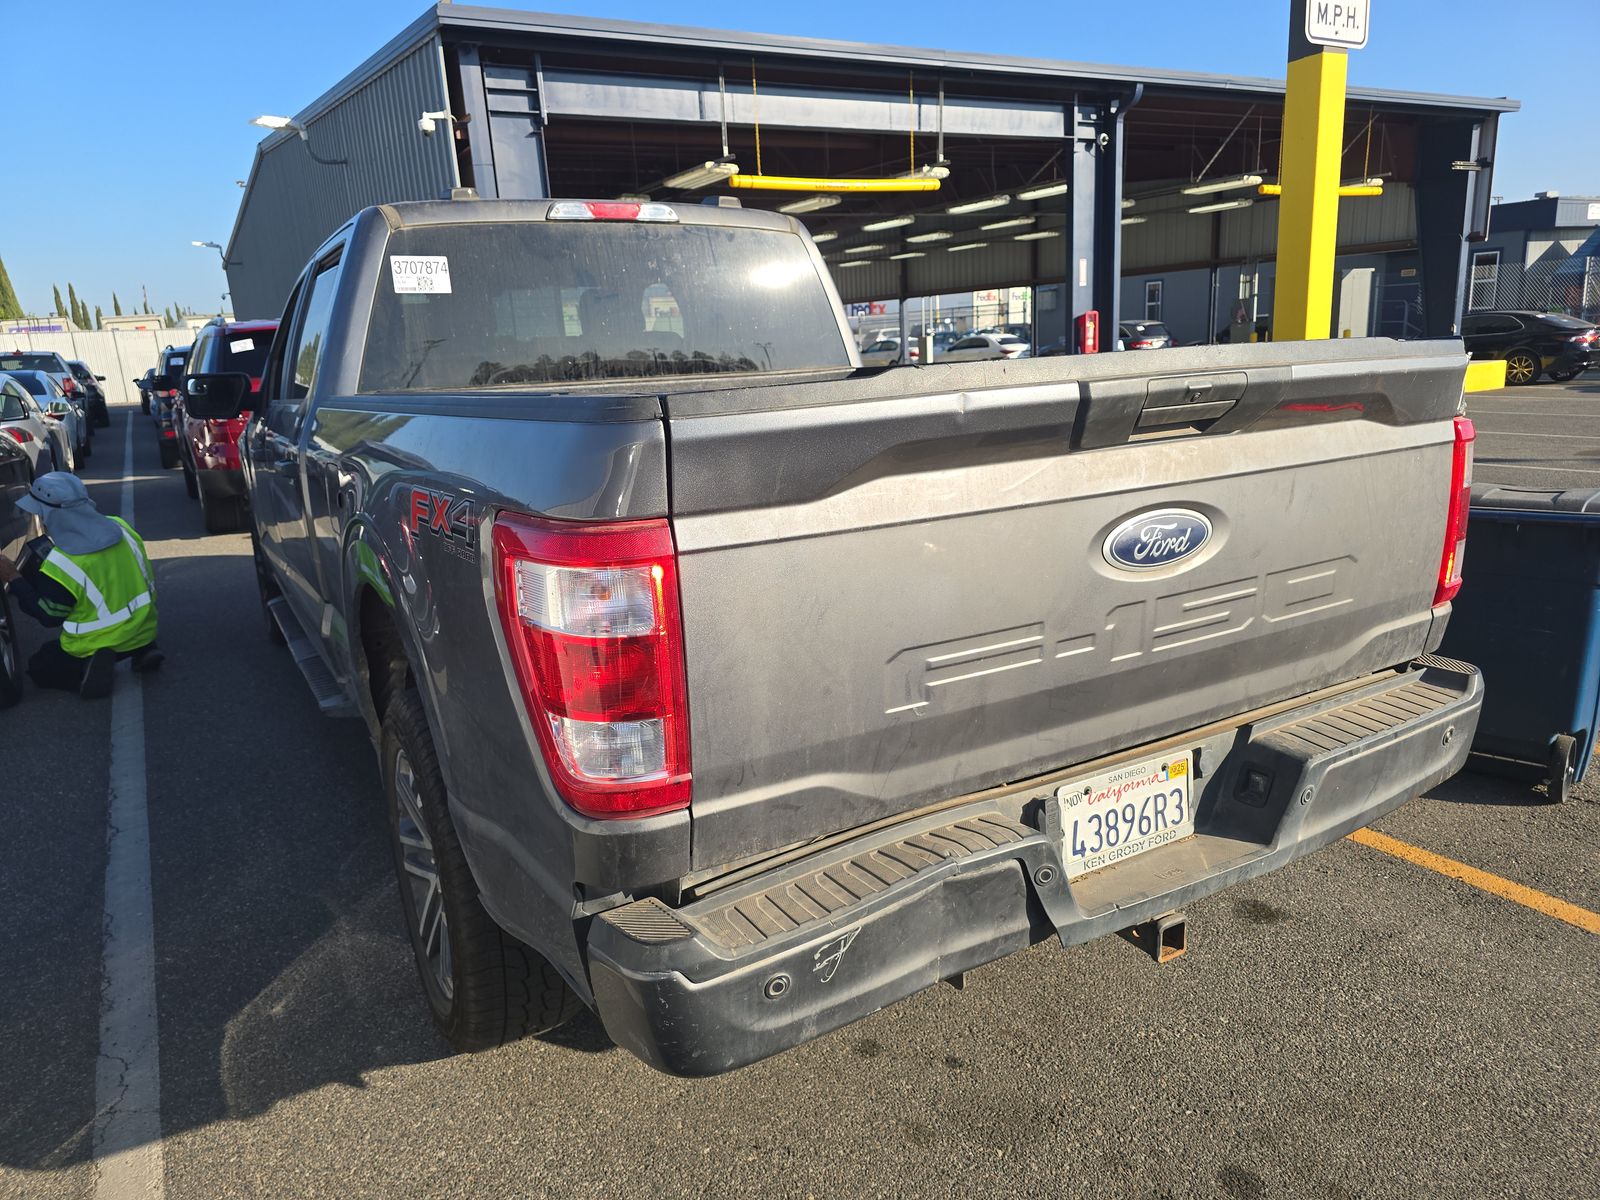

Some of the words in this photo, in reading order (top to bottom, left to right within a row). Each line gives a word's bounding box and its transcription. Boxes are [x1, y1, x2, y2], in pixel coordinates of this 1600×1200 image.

[1317, 2, 1359, 29] M.P.H.
[394, 260, 448, 275] 3707874
[410, 485, 476, 552] FX4
[1134, 522, 1192, 561] Ford
[885, 554, 1358, 714] F-150
[1108, 773, 1123, 784] SAN
[1124, 766, 1146, 779] DIEGO
[1072, 787, 1184, 858] 43896R3
[1083, 854, 1106, 871] KEN
[1108, 840, 1146, 861] GRODY
[1148, 829, 1177, 848] FORD
